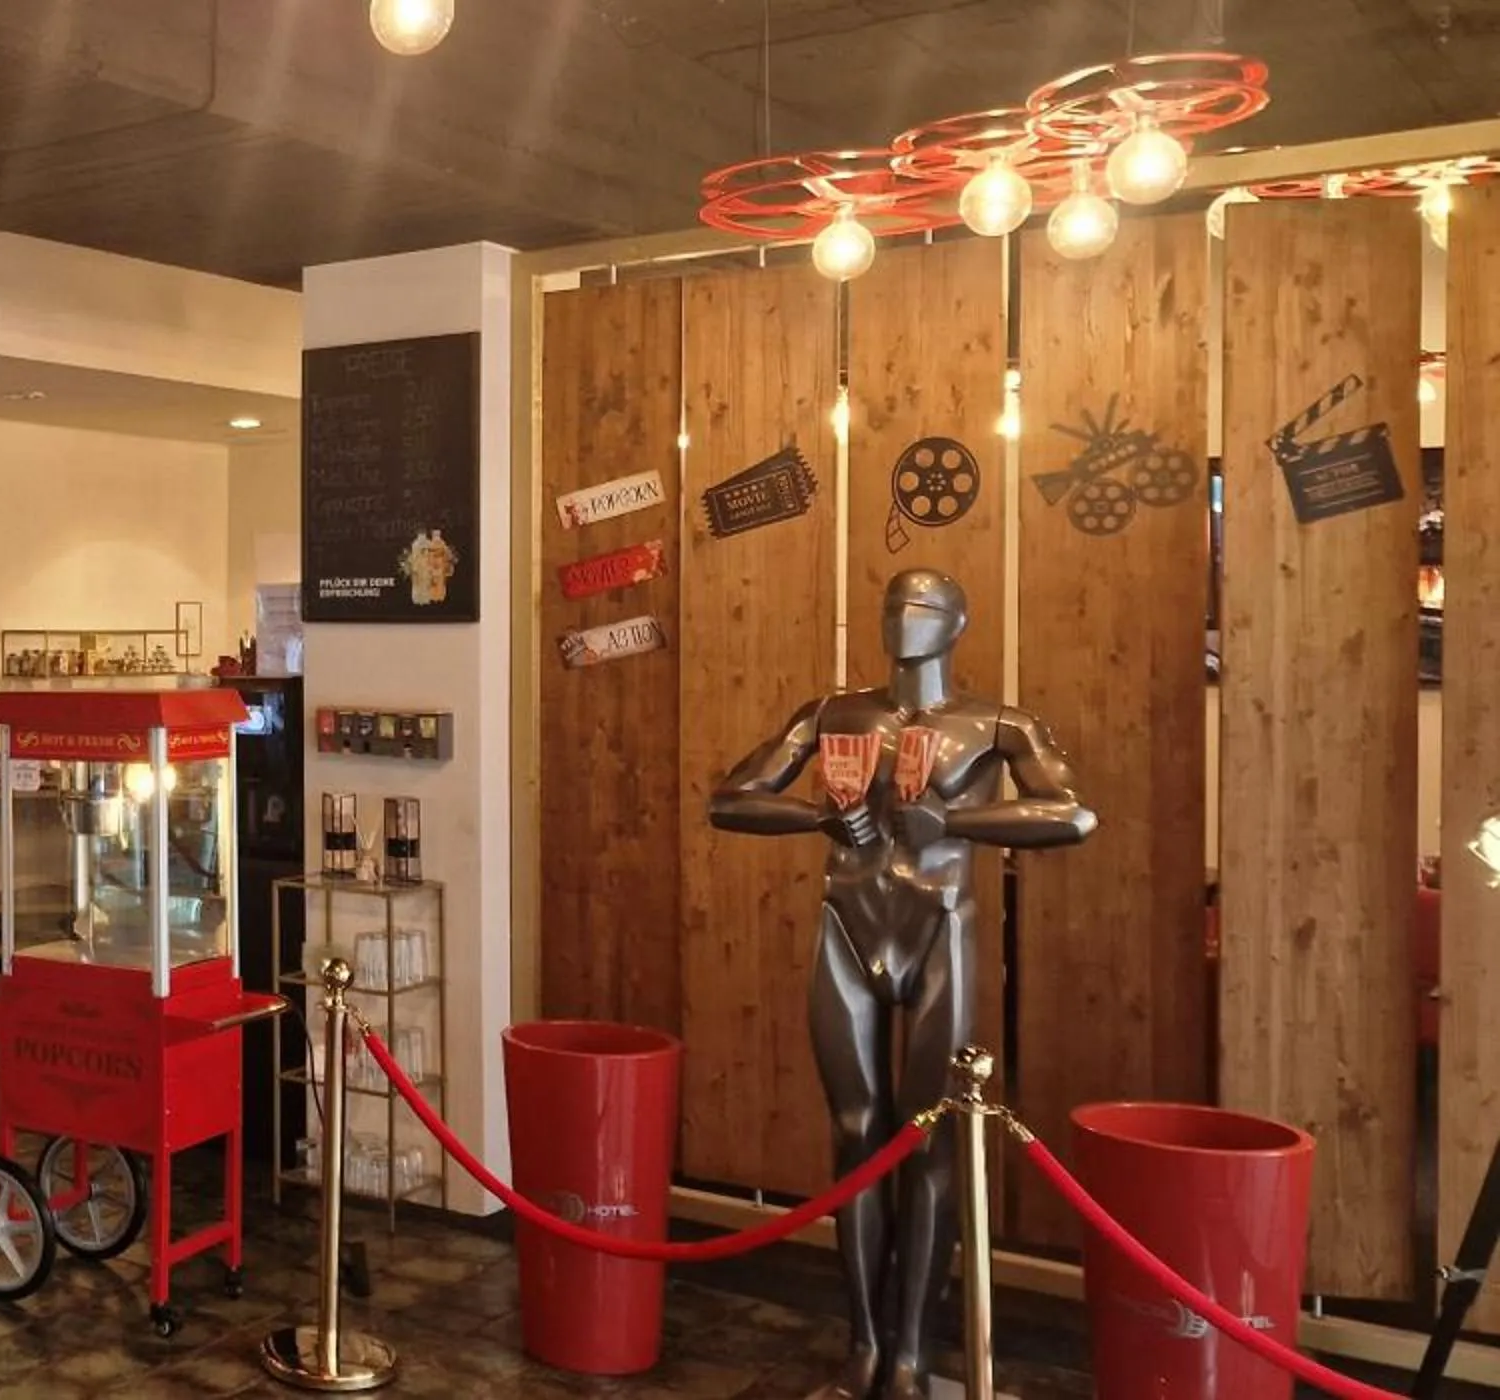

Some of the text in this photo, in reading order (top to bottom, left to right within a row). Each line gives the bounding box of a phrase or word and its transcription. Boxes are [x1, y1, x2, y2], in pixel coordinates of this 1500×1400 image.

[590, 479, 659, 514] POPCORN
[726, 490, 768, 509] MOVIE
[608, 620, 662, 650] ACTION
[14, 1035, 144, 1082] POPCORN
[587, 1205, 640, 1217] HOTEL
